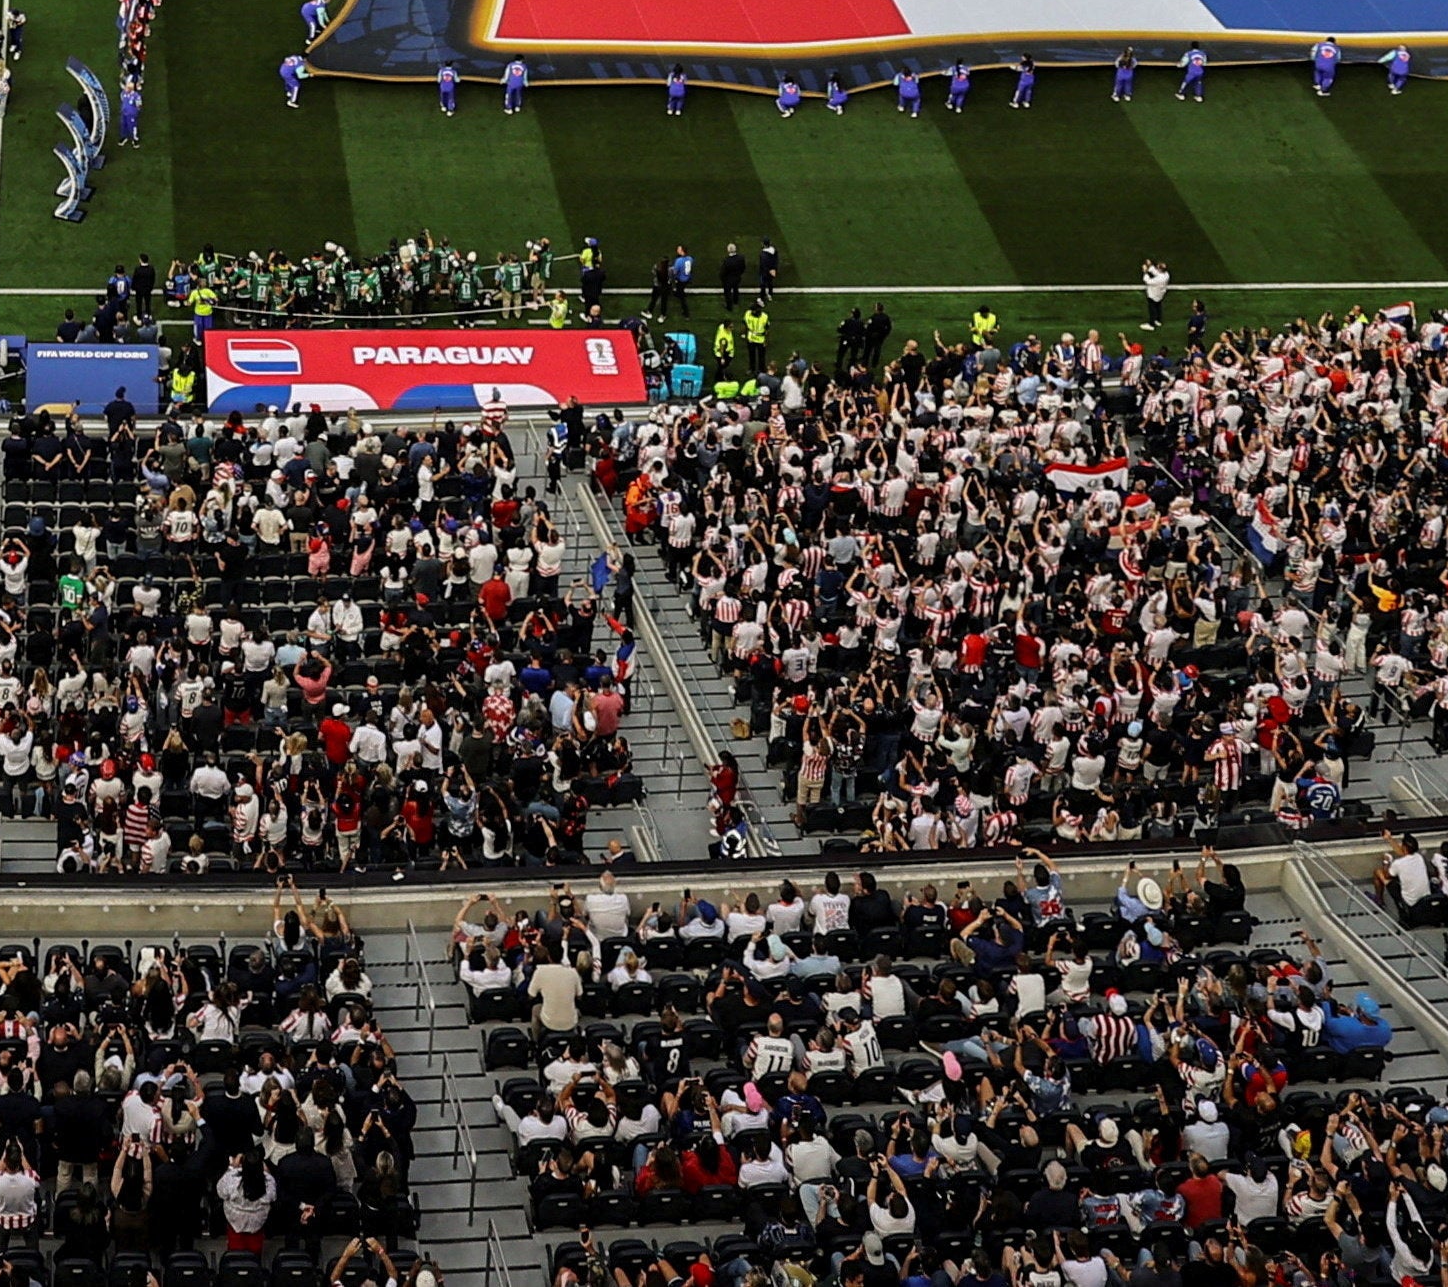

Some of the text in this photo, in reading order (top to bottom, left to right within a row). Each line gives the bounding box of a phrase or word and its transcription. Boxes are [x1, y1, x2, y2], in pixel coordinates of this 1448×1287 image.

[37, 350, 149, 359] FIFA WORLD CUP 2026
[353, 346, 534, 365] PARAGUAY
[665, 503, 678, 516] 16
[175, 522, 188, 533] 10
[63, 591, 76, 603] 10
[796, 659, 804, 670] 3
[2, 689, 10, 700] 8
[188, 691, 196, 704] 8
[232, 686, 245, 698] 10
[1313, 793, 1332, 810] 20
[1040, 900, 1061, 917] 26
[1301, 1030, 1319, 1047] 10
[864, 1039, 880, 1060] 10
[666, 1048, 680, 1073] 8
[769, 1054, 790, 1072] 11
